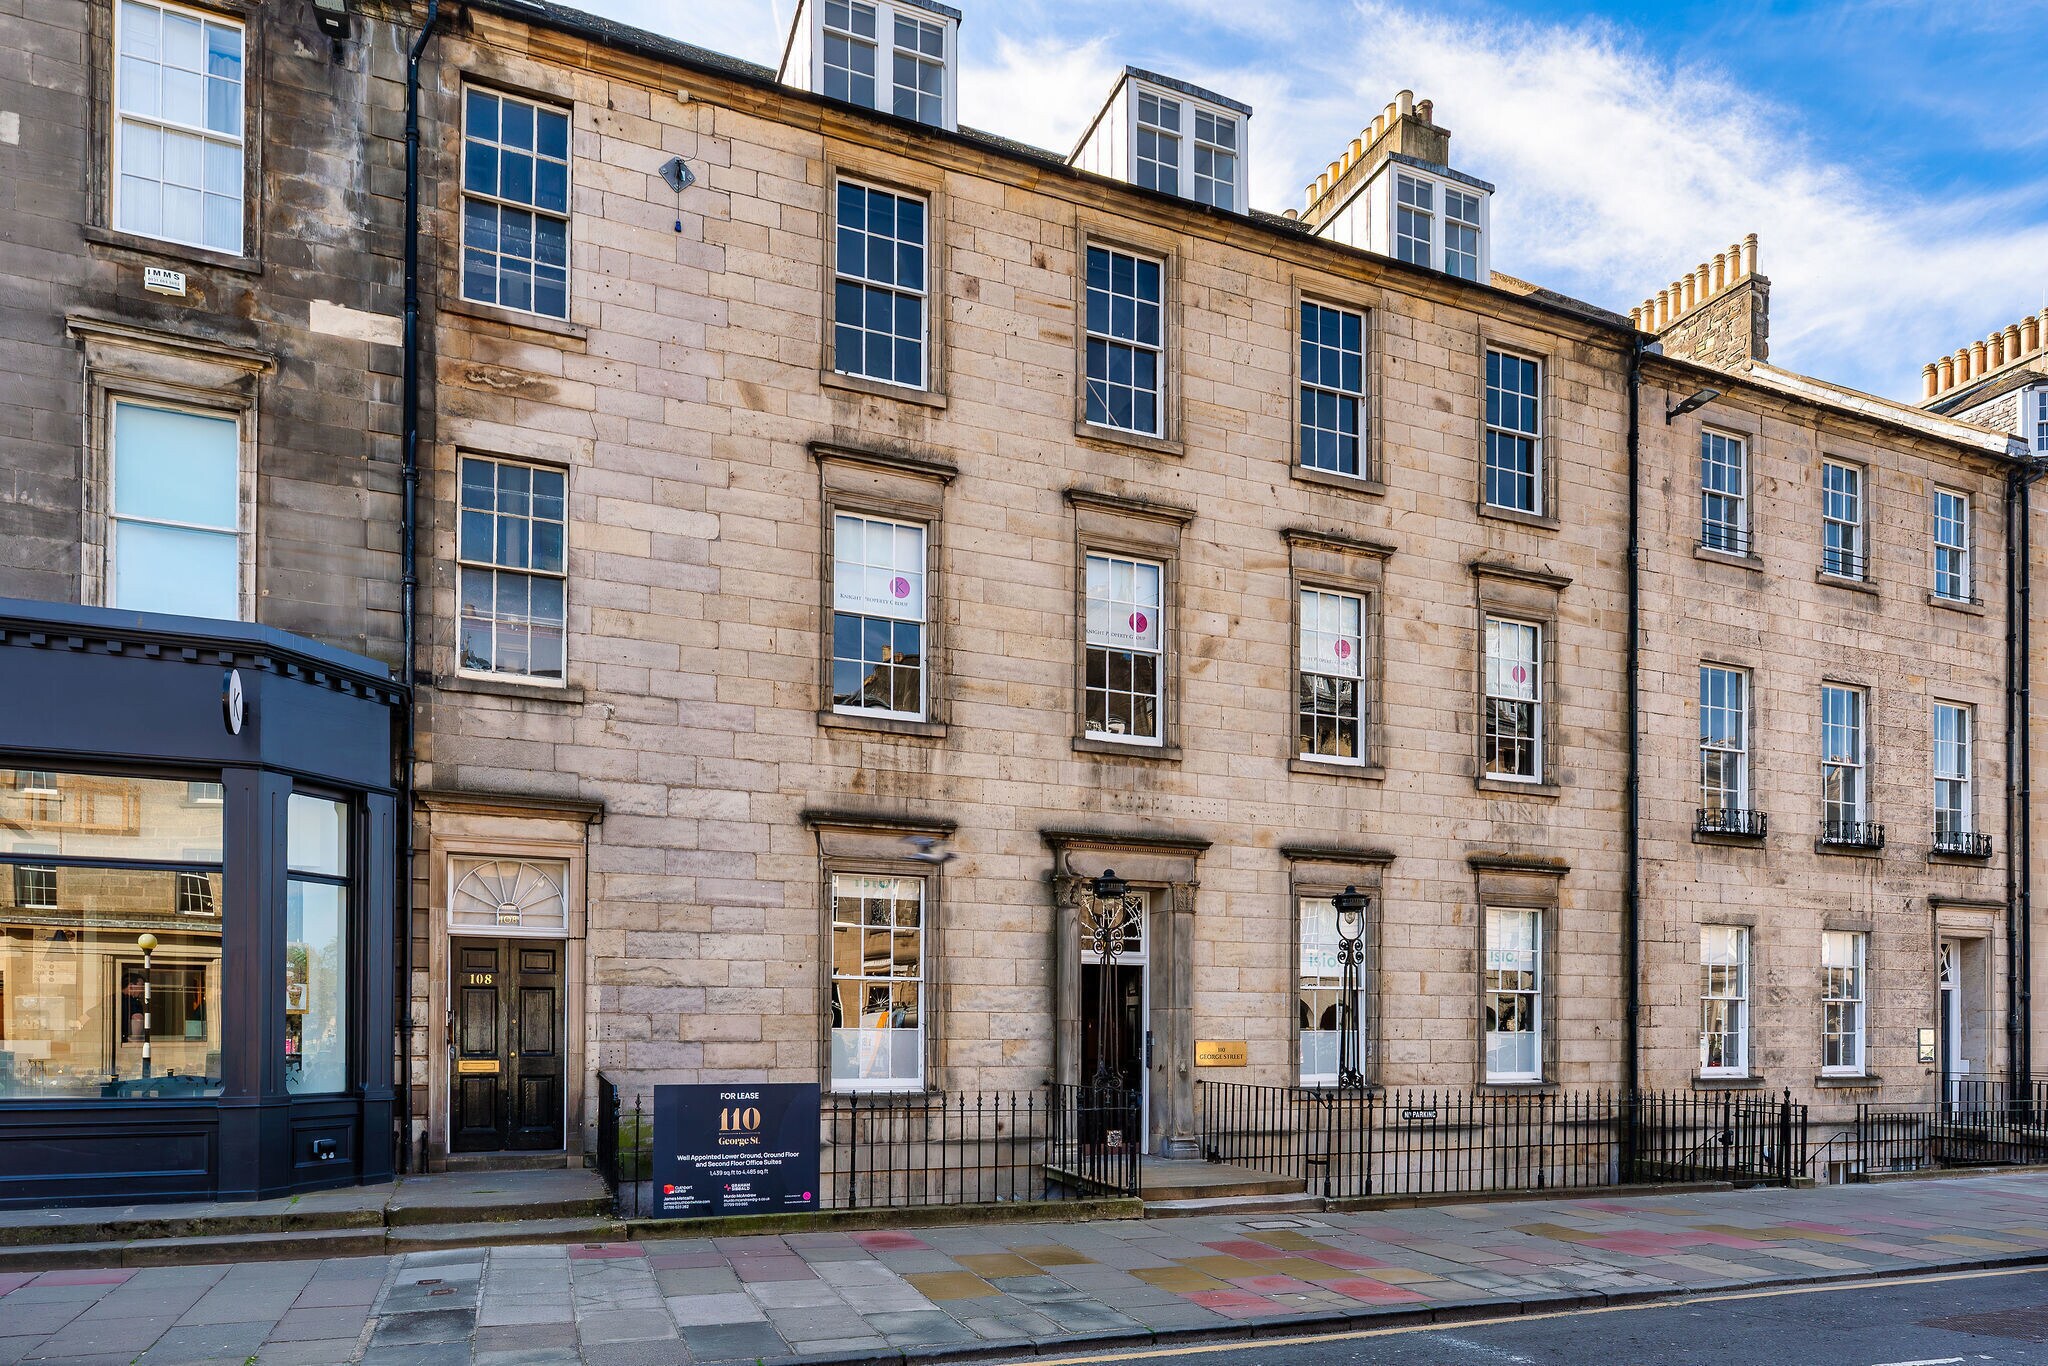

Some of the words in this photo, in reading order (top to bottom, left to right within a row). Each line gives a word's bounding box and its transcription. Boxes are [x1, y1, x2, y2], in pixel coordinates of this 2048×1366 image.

[147, 269, 180, 280] IMMS
[840, 593, 861, 601] KNIGHT
[1105, 631, 1128, 639] POPERTY
[233, 688, 240, 721] K
[500, 915, 518, 924] 108
[470, 974, 492, 984] 108
[720, 1092, 736, 1100] FOR
[737, 1092, 760, 1100] LEASE
[719, 1107, 761, 1131] 110
[718, 1136, 749, 1147] George
[750, 1136, 761, 1144] St.
[690, 1153, 721, 1162] Appointed
